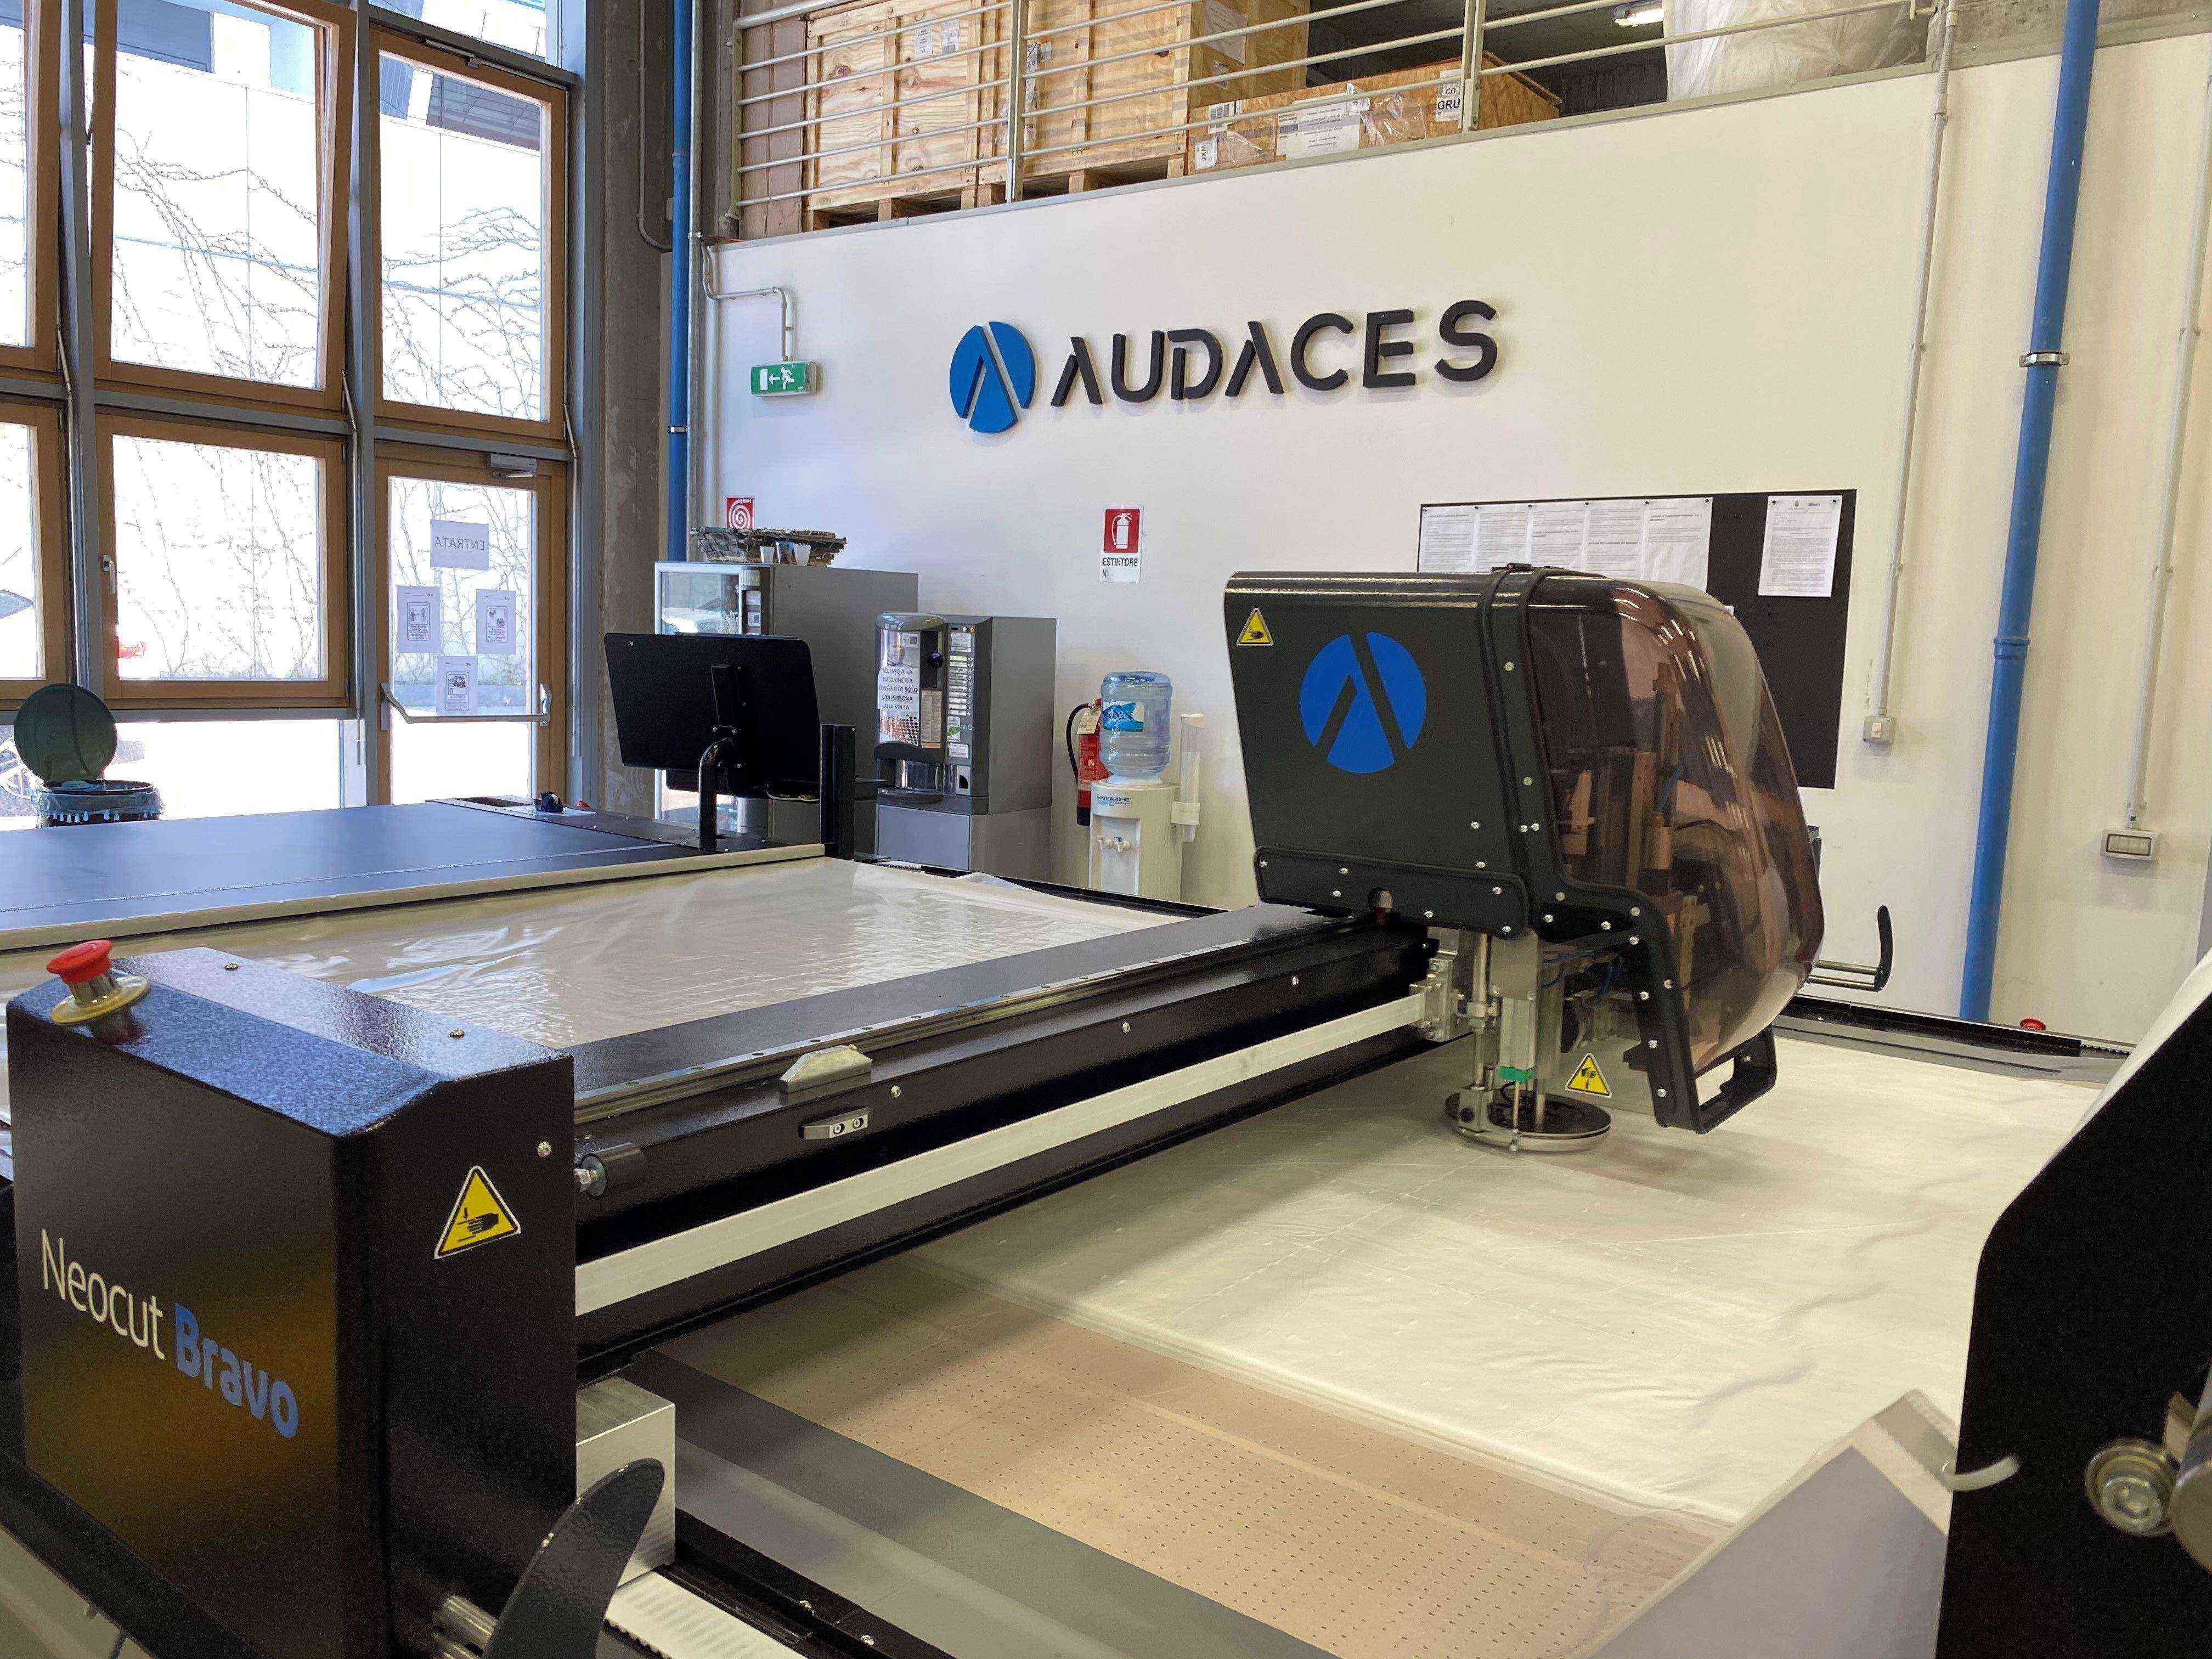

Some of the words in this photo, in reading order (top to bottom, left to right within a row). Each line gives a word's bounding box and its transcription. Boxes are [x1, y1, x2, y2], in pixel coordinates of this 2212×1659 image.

[1051, 300, 1497, 407] AUDACES
[1103, 557, 1138, 567] ESTINTORE
[41, 1228, 165, 1361] Neocut
[173, 1302, 299, 1438] Bravo
